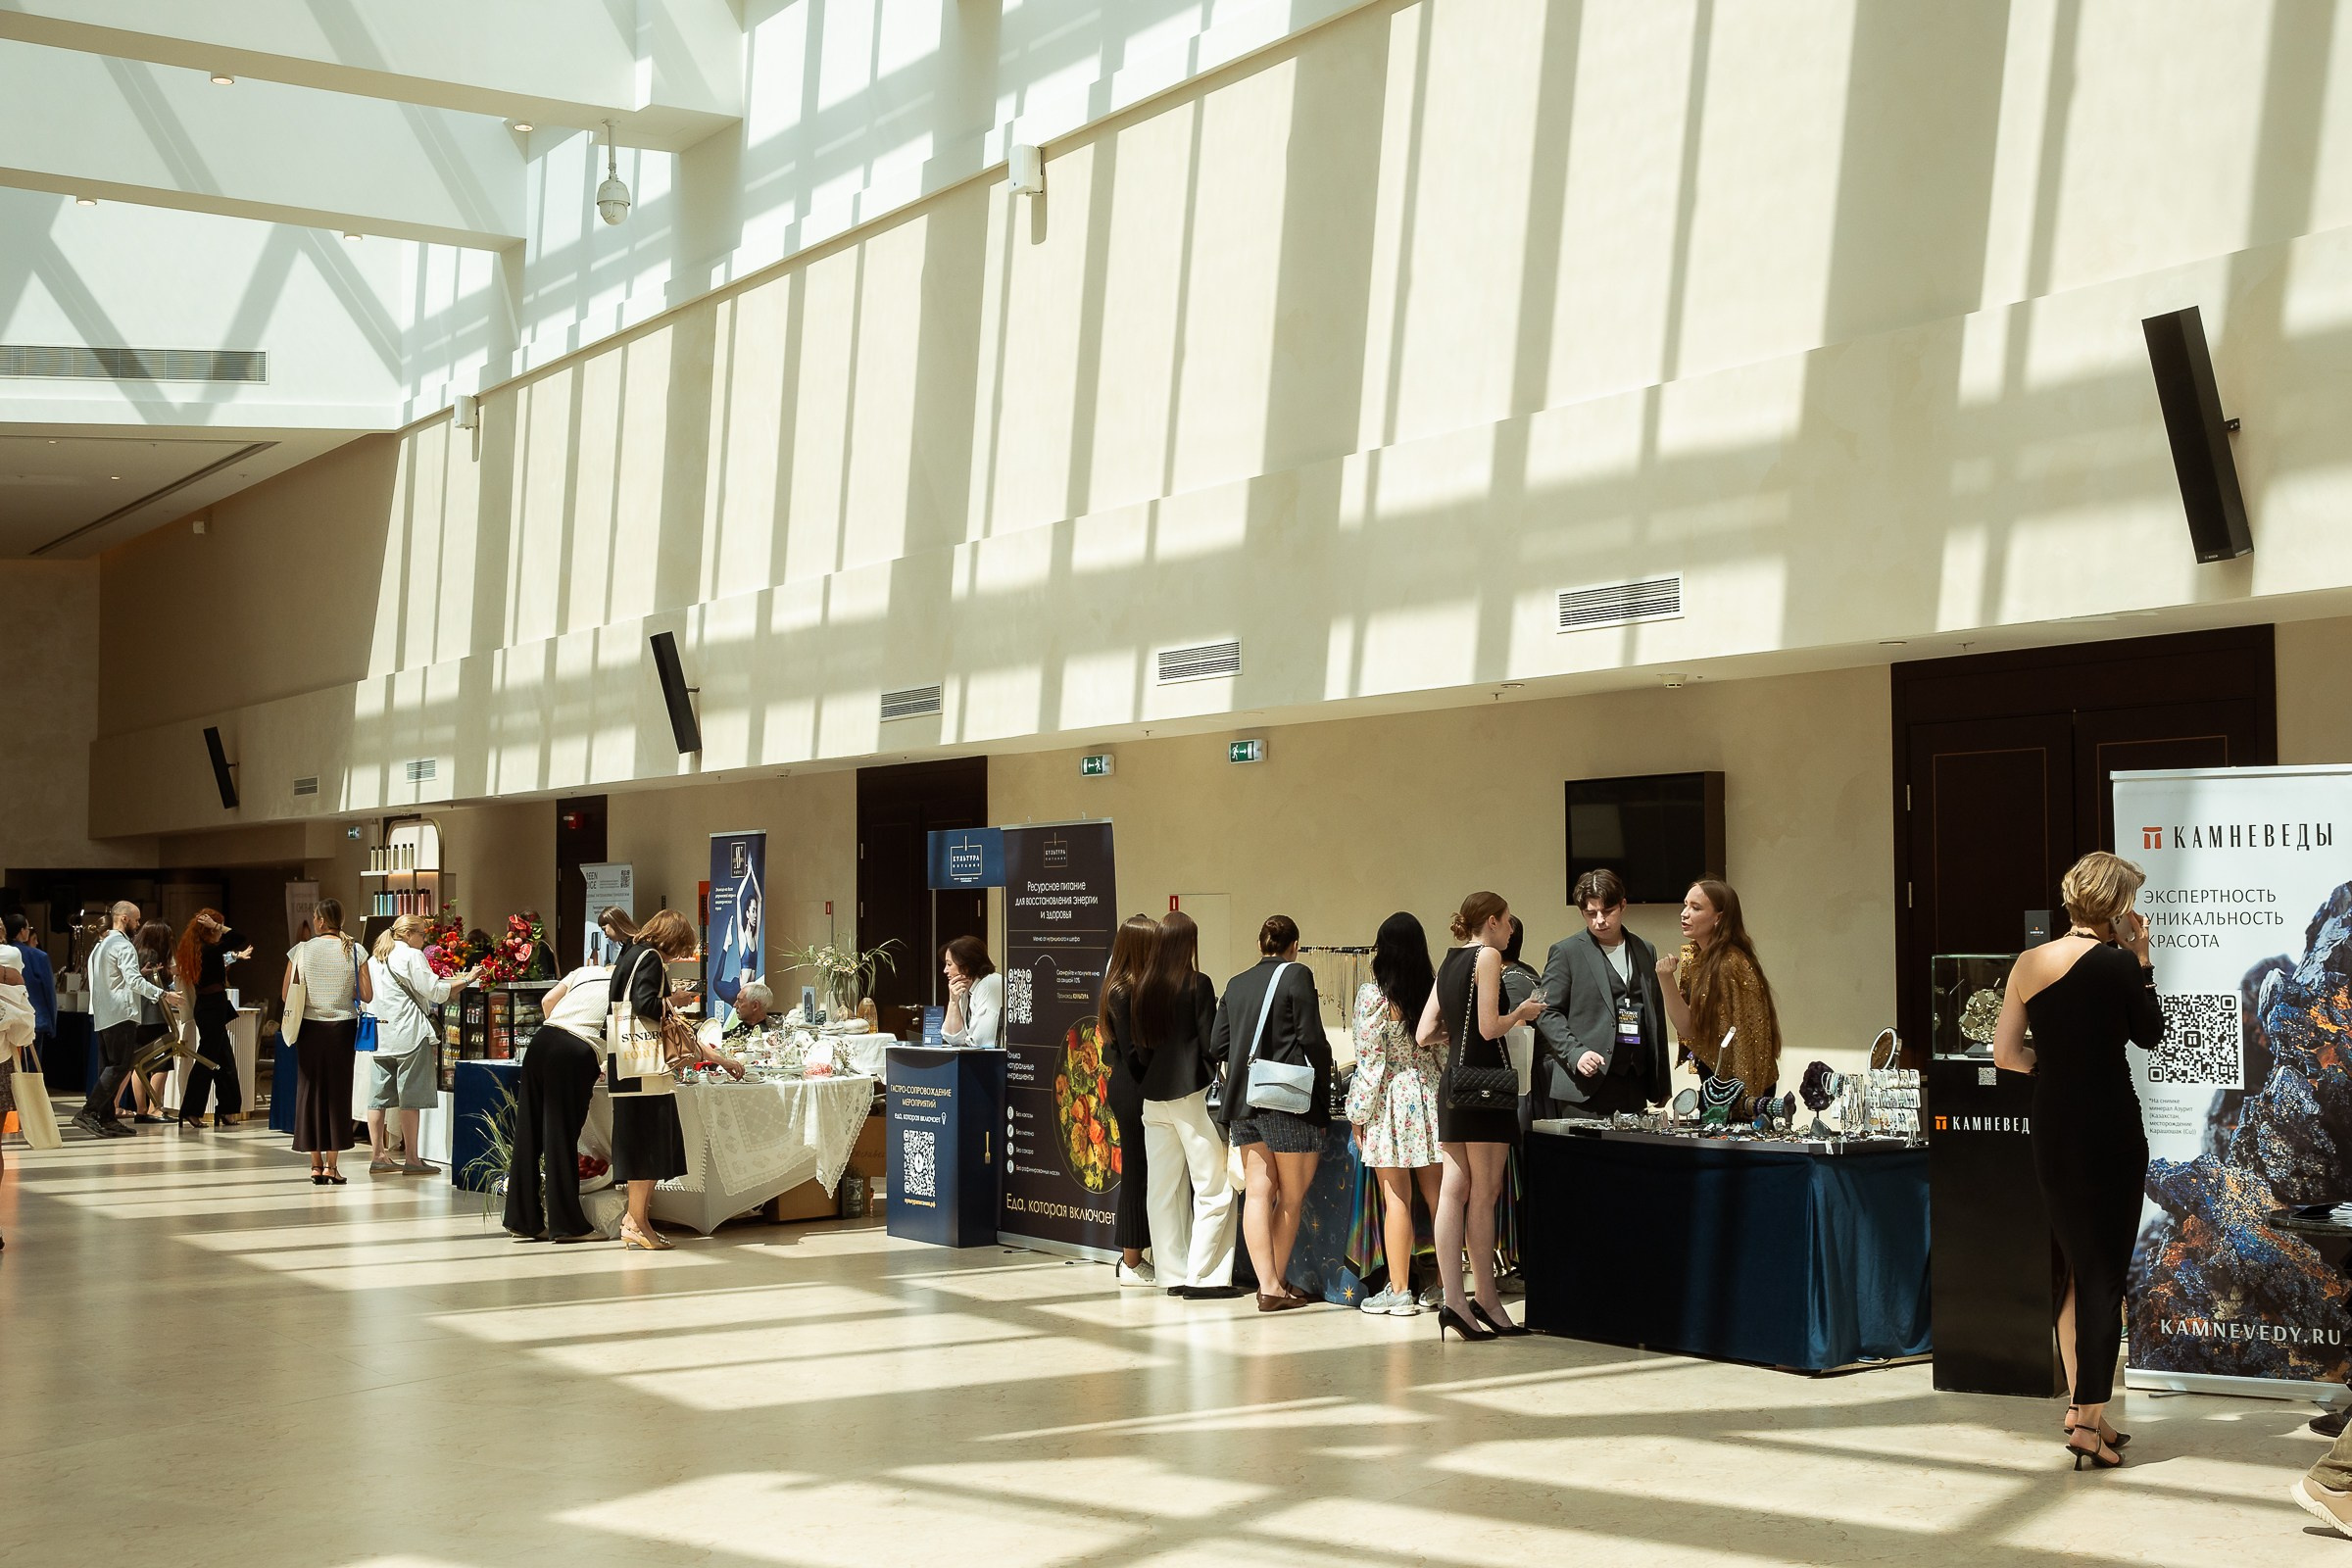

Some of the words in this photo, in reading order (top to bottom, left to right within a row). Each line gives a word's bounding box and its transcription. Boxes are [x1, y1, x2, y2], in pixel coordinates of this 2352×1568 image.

[2174, 823, 2332, 851] КАМНЕВЕДЫ
[1027, 881, 1059, 894] Ресурсное
[1060, 881, 1087, 891] питание
[1014, 897, 1025, 906] для
[1025, 896, 1072, 906] восстановления
[1073, 896, 1099, 906] энергии
[2143, 889, 2277, 904] ЭКСПЕРТНОСТЬ
[1046, 910, 1072, 921] здоровья
[2144, 911, 2284, 926] УНИКАЛЬНОСТЬ
[902, 1098, 937, 1108] МЕРОПРИЯТИЙ
[1006, 1193, 1026, 1212] Еда,
[1028, 1200, 1067, 1219] которая
[1070, 1206, 1116, 1225] включает
[2161, 1319, 2341, 1346] KAMNEVEDY.RU
